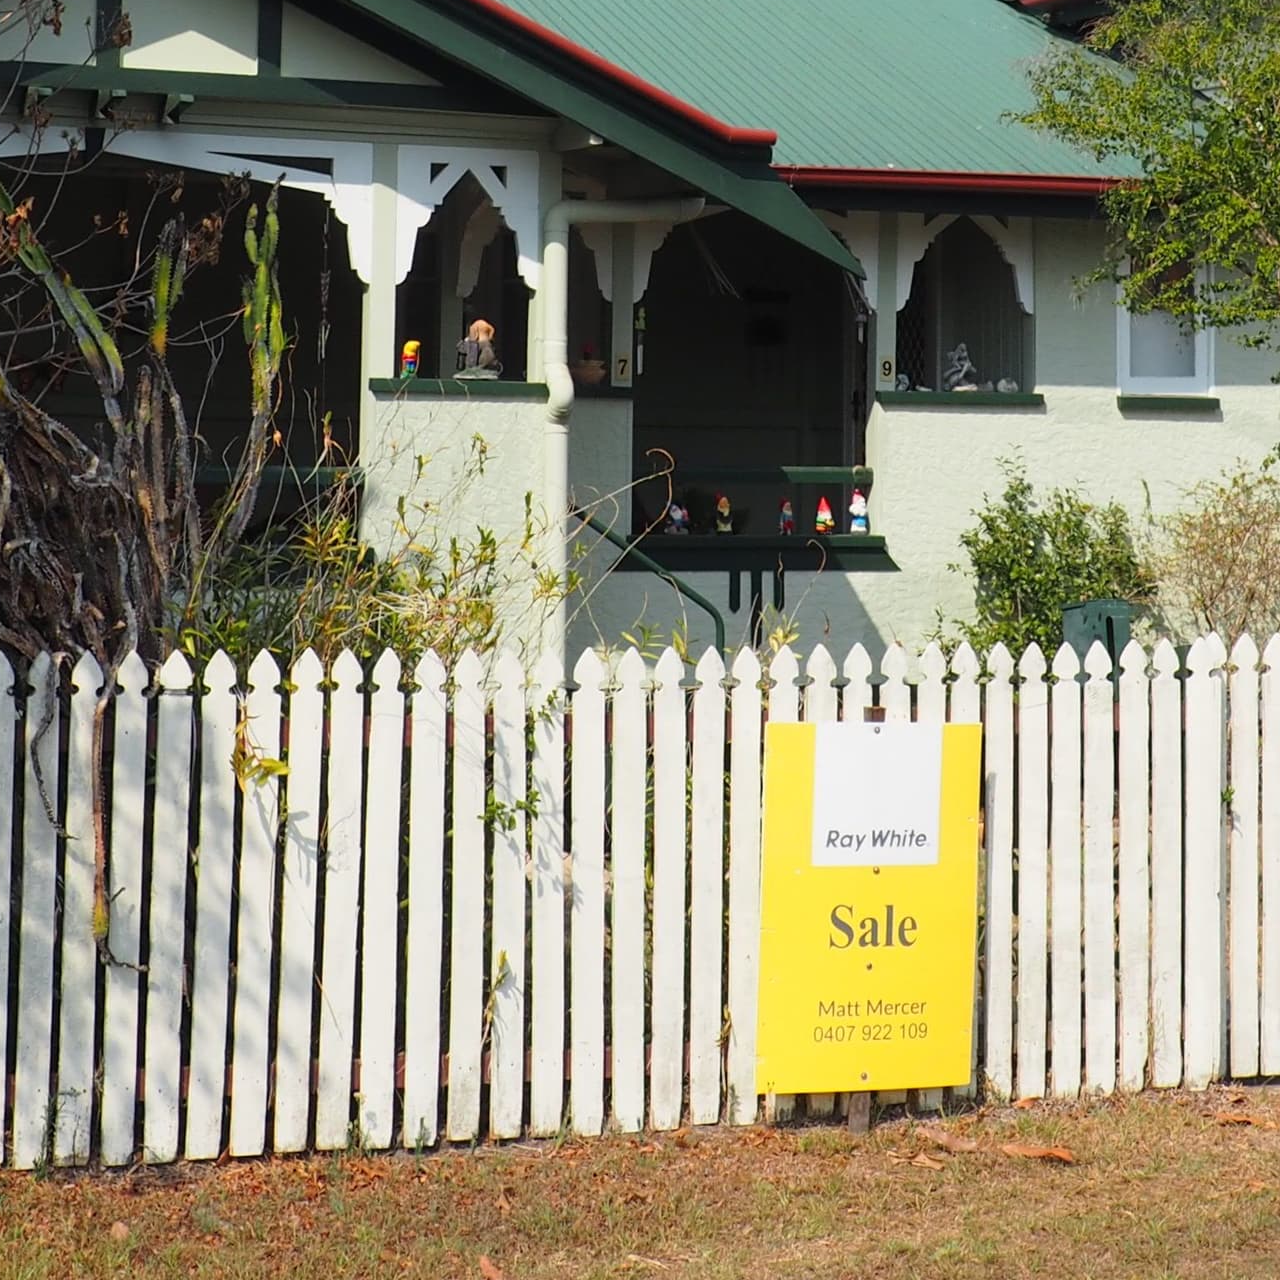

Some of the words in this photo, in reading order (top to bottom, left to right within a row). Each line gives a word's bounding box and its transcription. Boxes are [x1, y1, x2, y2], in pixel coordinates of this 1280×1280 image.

[618, 359, 628, 376] 7
[882, 360, 892, 377] 9
[825, 829, 867, 852] Ray
[871, 828, 927, 848] White
[829, 904, 920, 949] Sale
[818, 1000, 860, 1017] Matt
[866, 999, 927, 1017] Mercer
[813, 1024, 856, 1042] 0407
[861, 1023, 893, 1041] 922
[900, 1022, 928, 1040] 109
